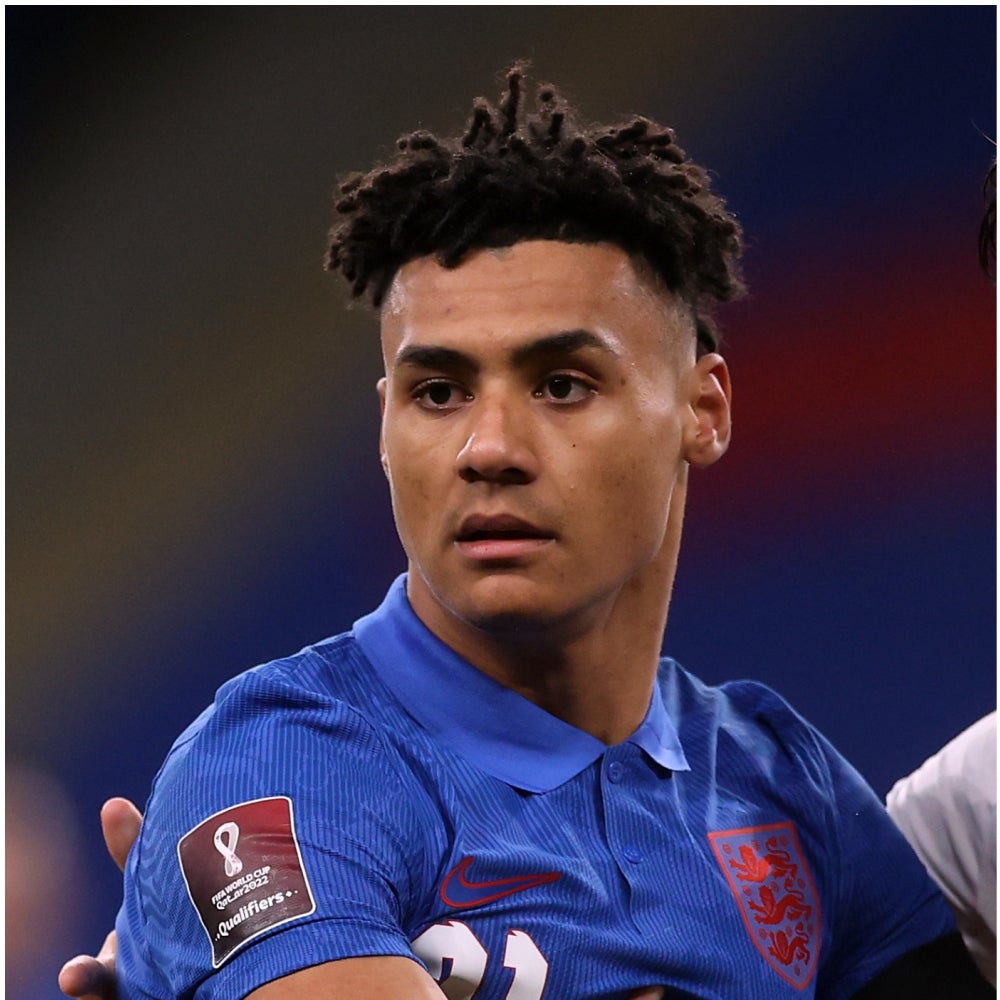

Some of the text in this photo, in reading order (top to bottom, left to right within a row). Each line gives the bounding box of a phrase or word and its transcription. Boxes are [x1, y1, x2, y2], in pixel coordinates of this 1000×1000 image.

[211, 865, 271, 905] FIFA WORLD CUP
[218, 892, 285, 937] Qualifiers
